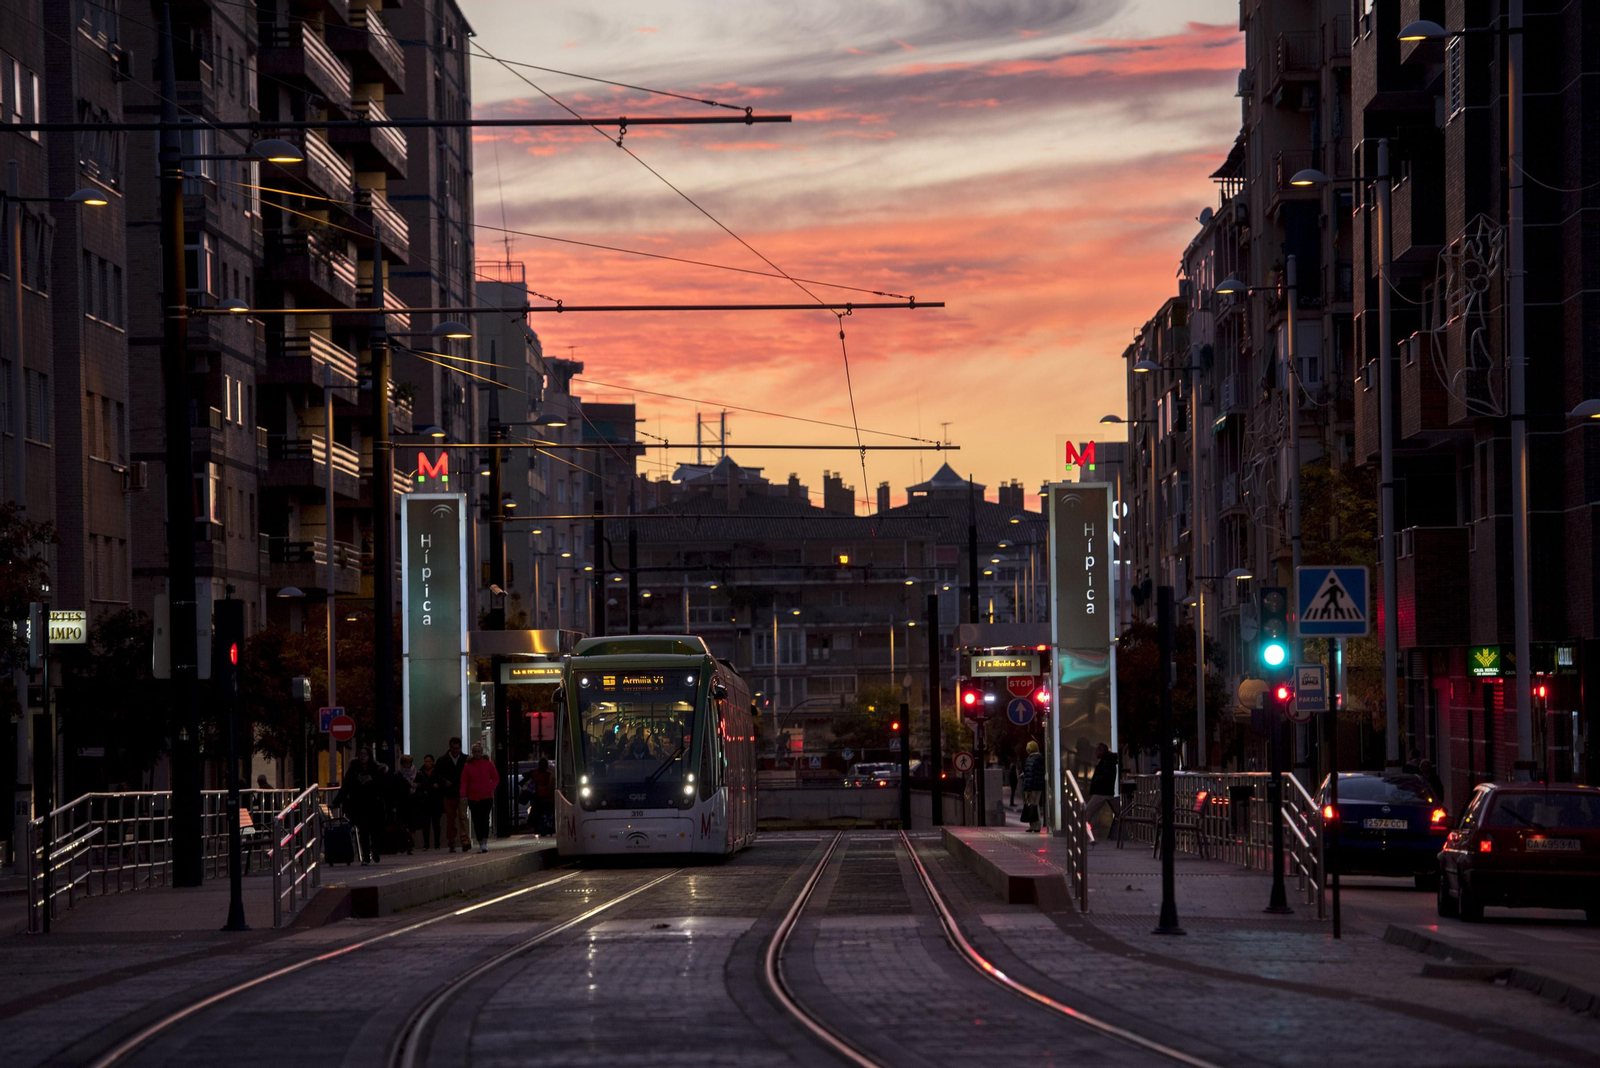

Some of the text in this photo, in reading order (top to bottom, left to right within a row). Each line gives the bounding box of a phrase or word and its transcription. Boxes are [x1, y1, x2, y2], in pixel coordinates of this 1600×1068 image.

[1066, 440, 1096, 471] M
[417, 451, 449, 482] M
[1083, 522, 1096, 615] Hípica
[420, 533, 432, 626] Hípica
[50, 612, 82, 622] RTES
[50, 627, 82, 641] IMPO
[622, 676, 652, 685] Armilla
[1009, 680, 1033, 688] STOP
[1368, 819, 1389, 828] 2574
